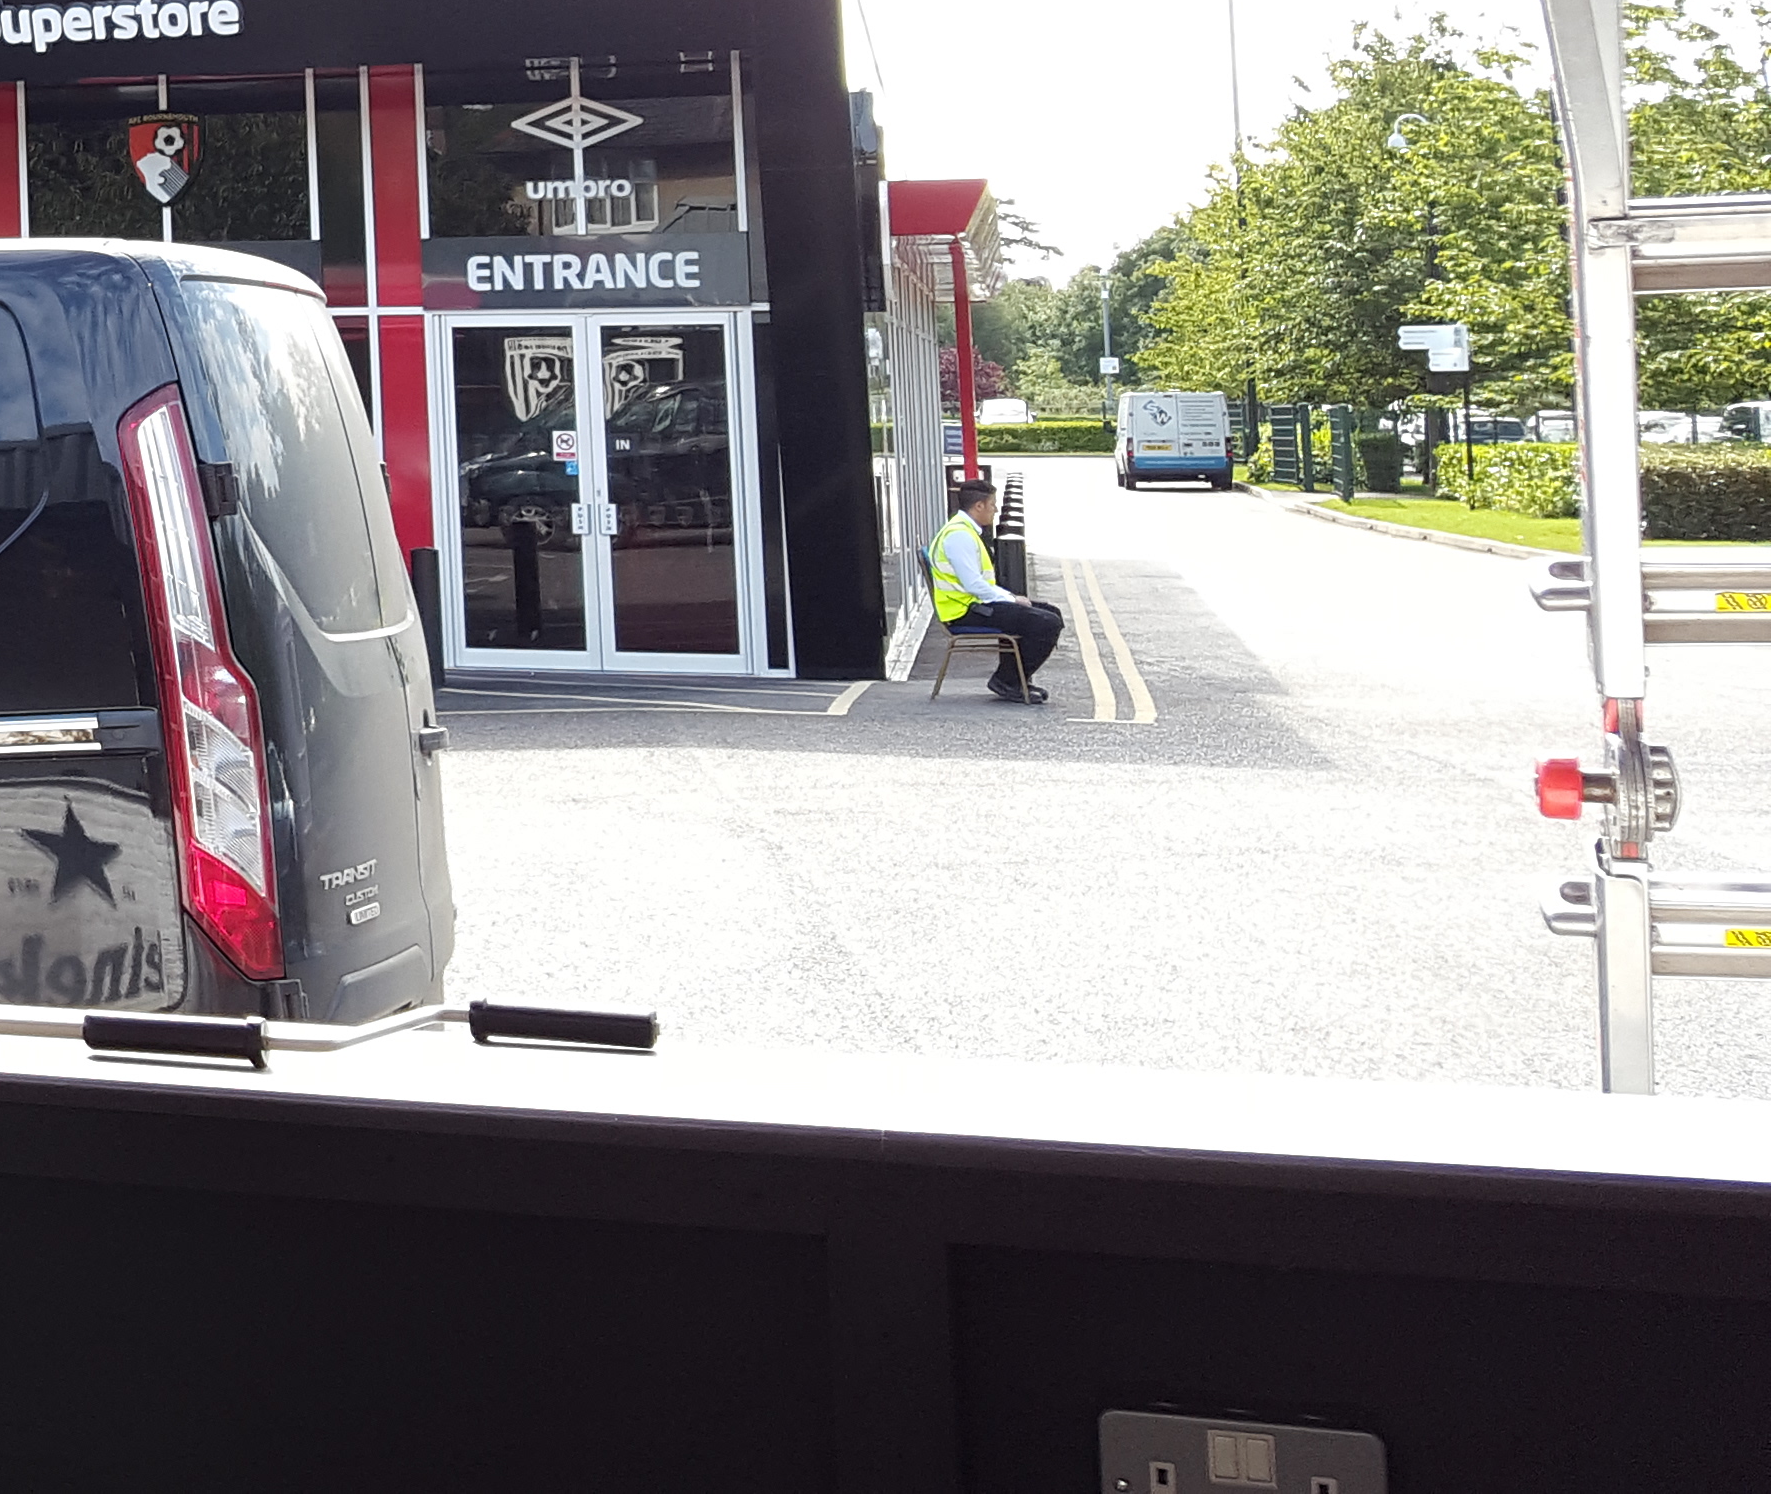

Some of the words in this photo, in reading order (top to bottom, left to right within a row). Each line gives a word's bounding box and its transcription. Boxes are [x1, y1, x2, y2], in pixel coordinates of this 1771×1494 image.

[466, 250, 701, 292] ENTRANCE
[615, 438, 631, 451] IN
[319, 858, 378, 890] TRANSIT
